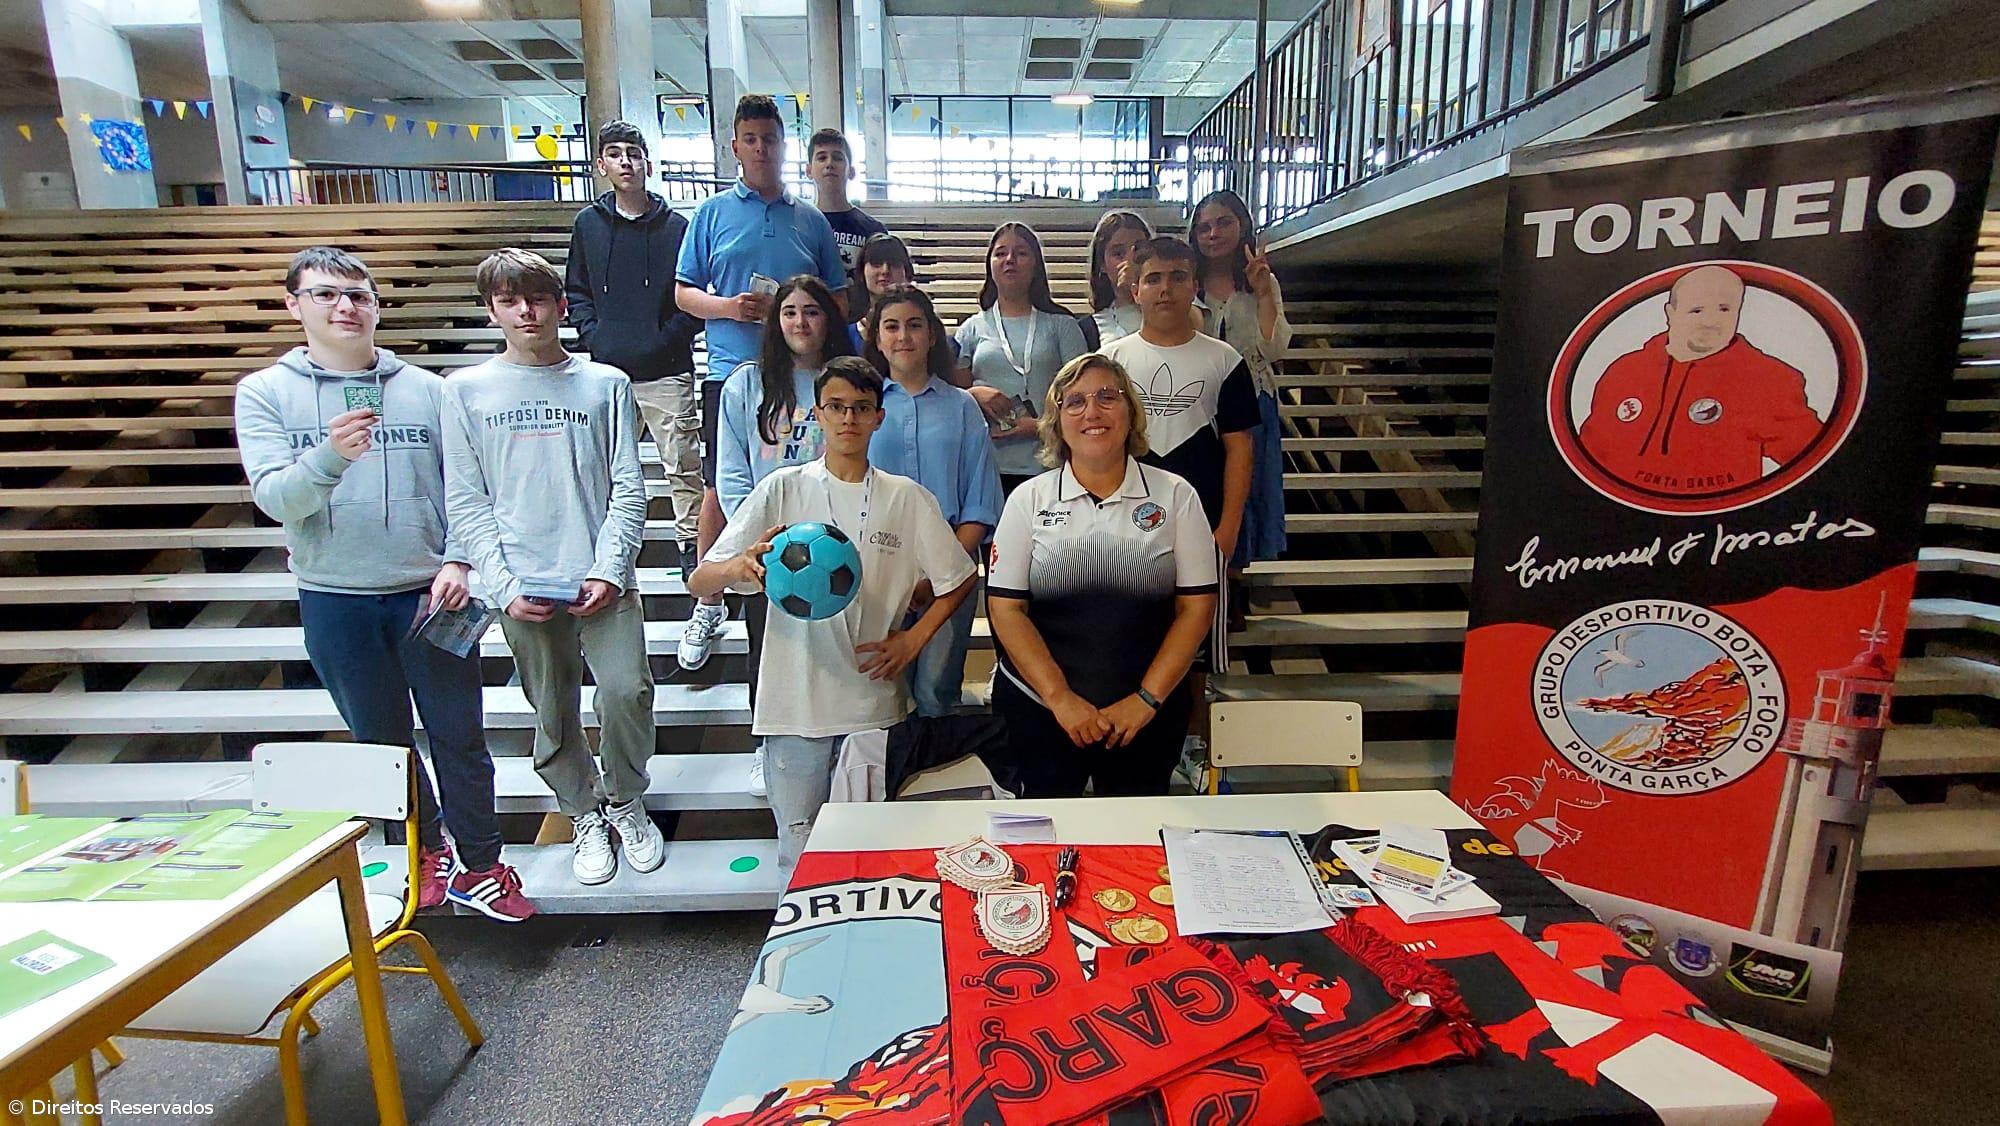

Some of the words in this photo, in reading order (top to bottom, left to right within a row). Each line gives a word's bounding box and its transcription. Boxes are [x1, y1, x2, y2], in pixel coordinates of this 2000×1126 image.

[1523, 169, 1956, 258] TORNEIO
[833, 231, 866, 247] DREAM
[485, 408, 538, 430] TIFFOSI
[545, 408, 589, 427] DENIM
[509, 423, 539, 431] SUPERIOR
[540, 422, 565, 430] QUALITY
[1634, 470, 1678, 488] PONTA
[1540, 652, 1565, 719] GRUPO
[1559, 604, 1711, 651] DESPORTIVO
[1713, 624, 1769, 677] BOTA
[1743, 695, 1779, 754] FOGO
[1565, 740, 1633, 786] PONTA
[1641, 766, 1728, 789] GARÇA
[1462, 838, 1514, 856] de
